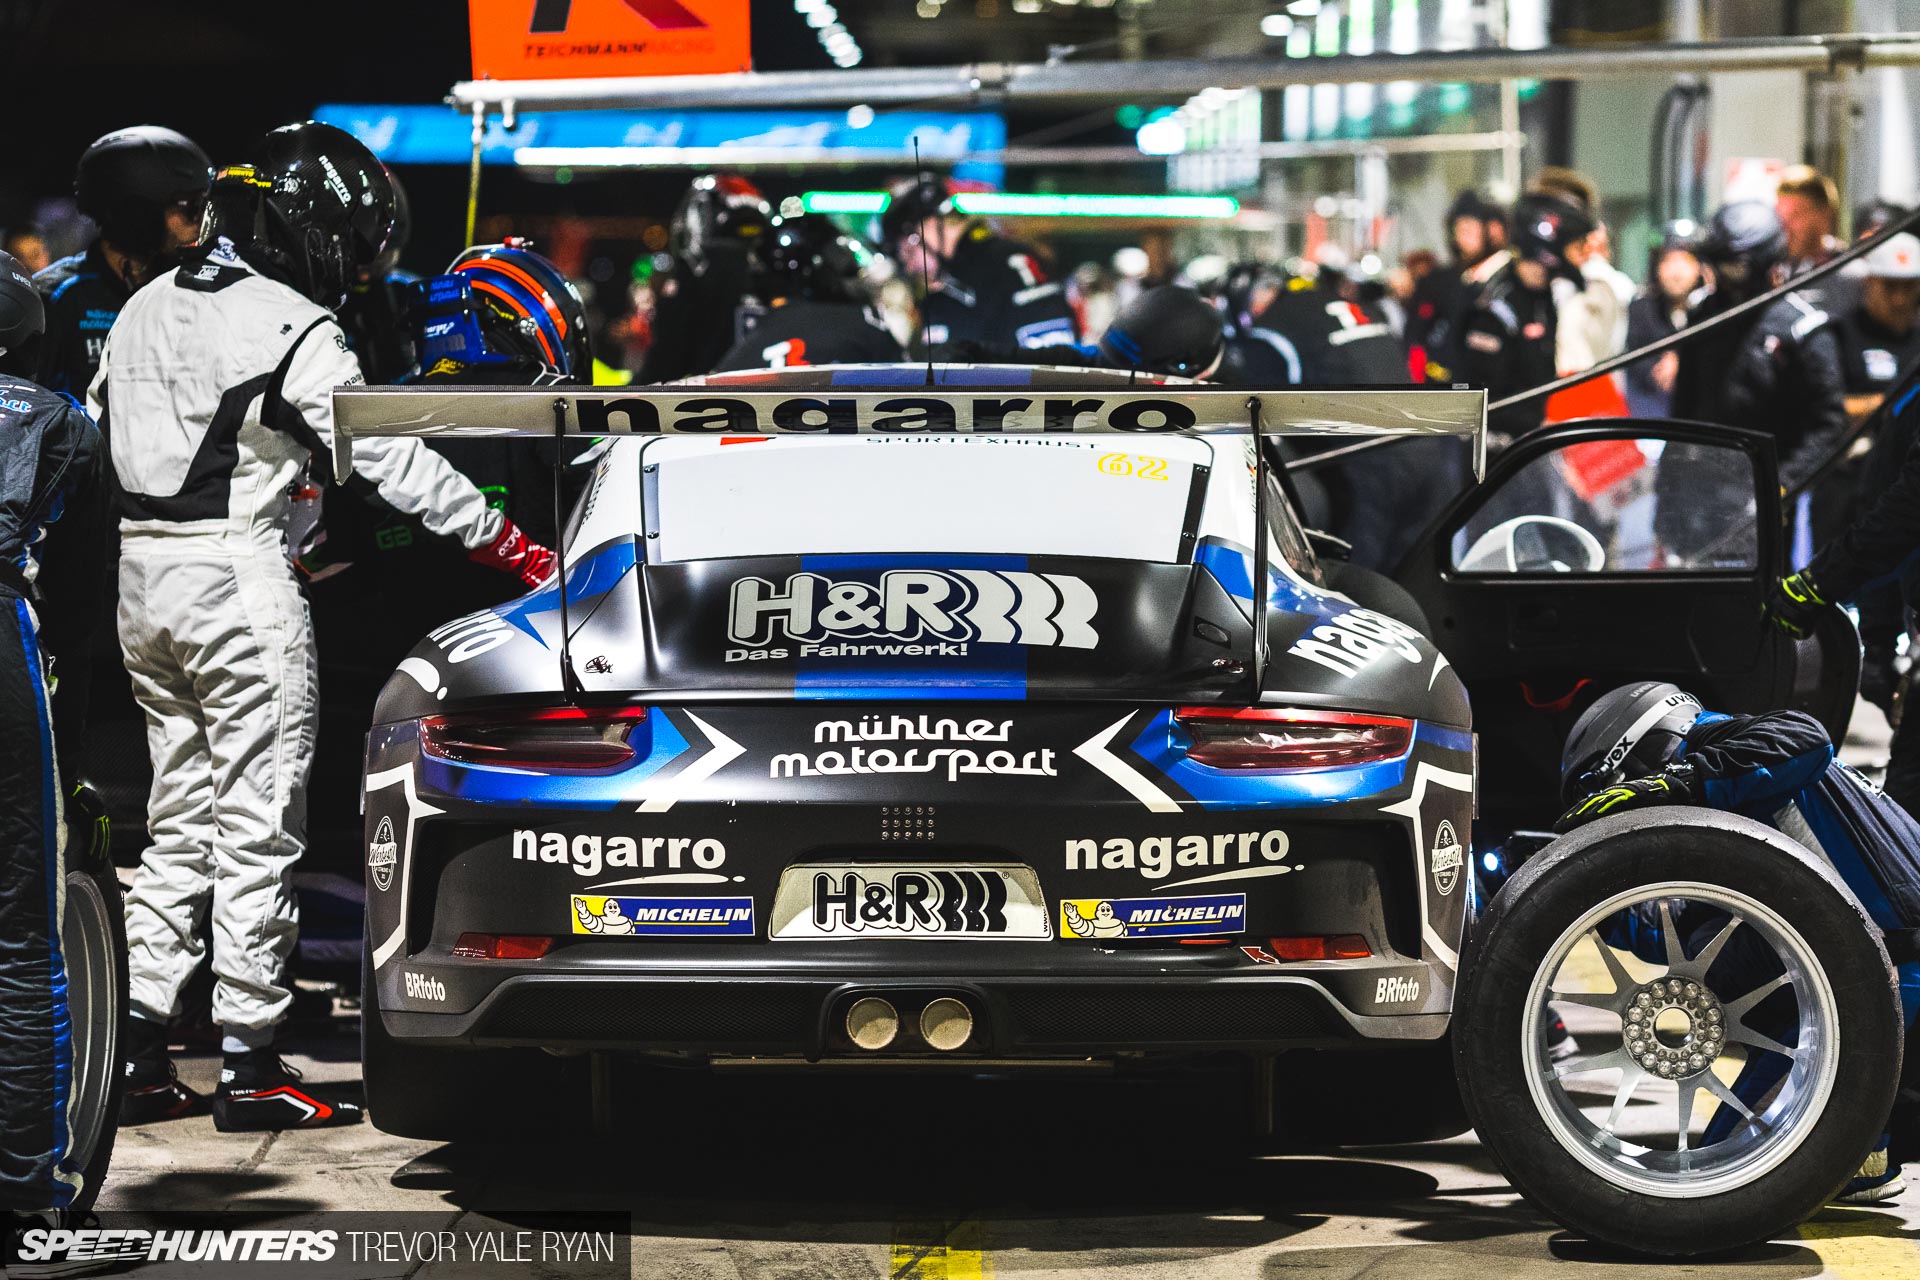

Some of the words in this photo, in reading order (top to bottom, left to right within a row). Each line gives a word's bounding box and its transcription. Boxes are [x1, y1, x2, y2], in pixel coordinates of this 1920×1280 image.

[318, 155, 351, 202] nagarro
[576, 398, 1197, 433] nagarro
[1098, 453, 1169, 481] 62
[727, 570, 973, 647] H&R
[725, 648, 789, 663] Das
[800, 642, 968, 659] Fahrwerk!
[1630, 682, 1657, 698] uvex
[814, 715, 1014, 743] mühlner
[770, 747, 1058, 782] motorsport
[513, 829, 726, 877] nagarro
[1066, 829, 1290, 879] nagarro
[636, 908, 751, 922] MICHELIN
[813, 872, 942, 932] H&R
[1129, 904, 1243, 923] MICHELIN
[405, 971, 446, 1002] BRfoto
[1375, 976, 1420, 1004] BRfoto
